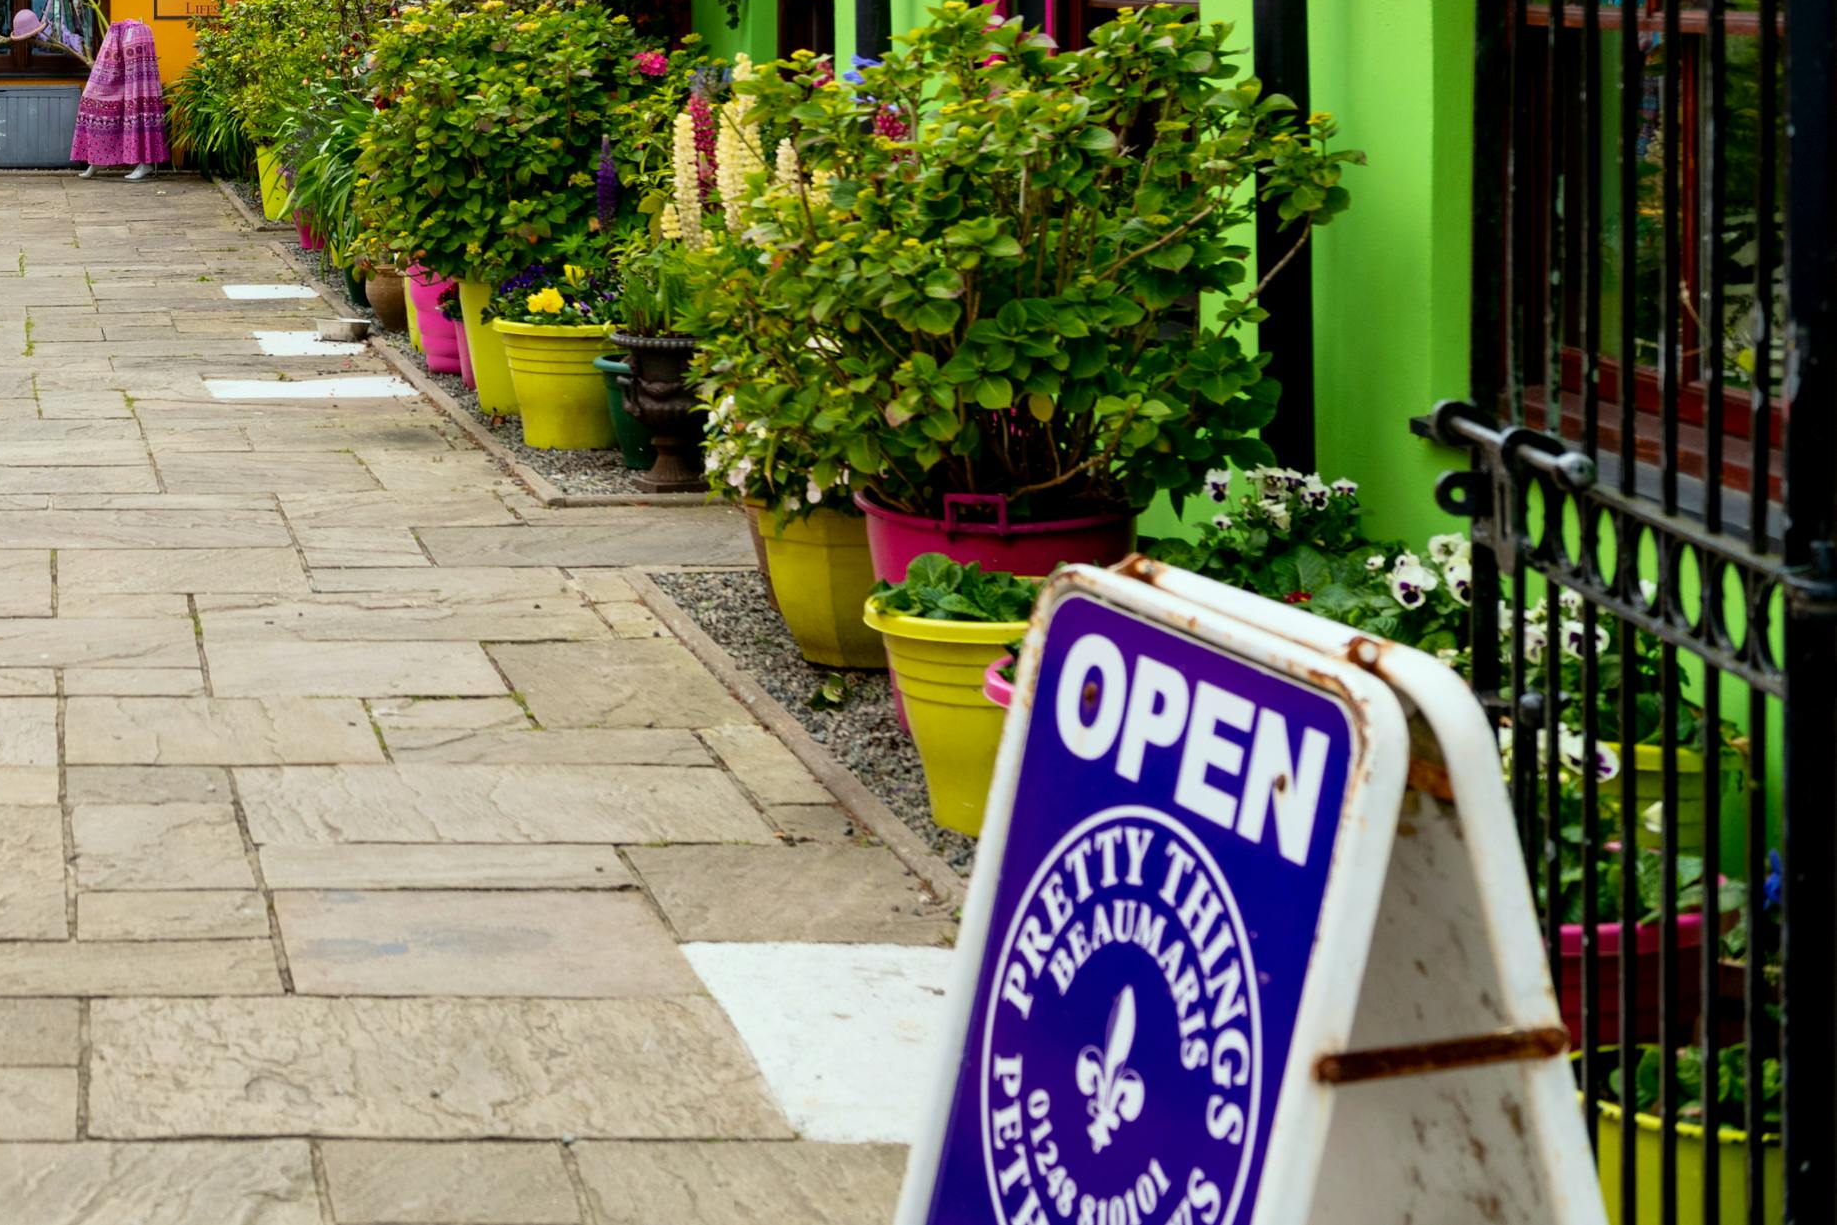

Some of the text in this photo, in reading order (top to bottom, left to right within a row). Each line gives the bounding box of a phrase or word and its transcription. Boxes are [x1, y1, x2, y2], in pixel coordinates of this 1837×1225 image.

[186, 2, 220, 15] LIFES
[1054, 631, 1332, 868] OPEN
[1000, 824, 1252, 1145] PRETTY THINGS
[1047, 898, 1210, 1071] BEAUMARIS
[1026, 1087, 1078, 1218] 01248
[1076, 1156, 1172, 1225] 810101
